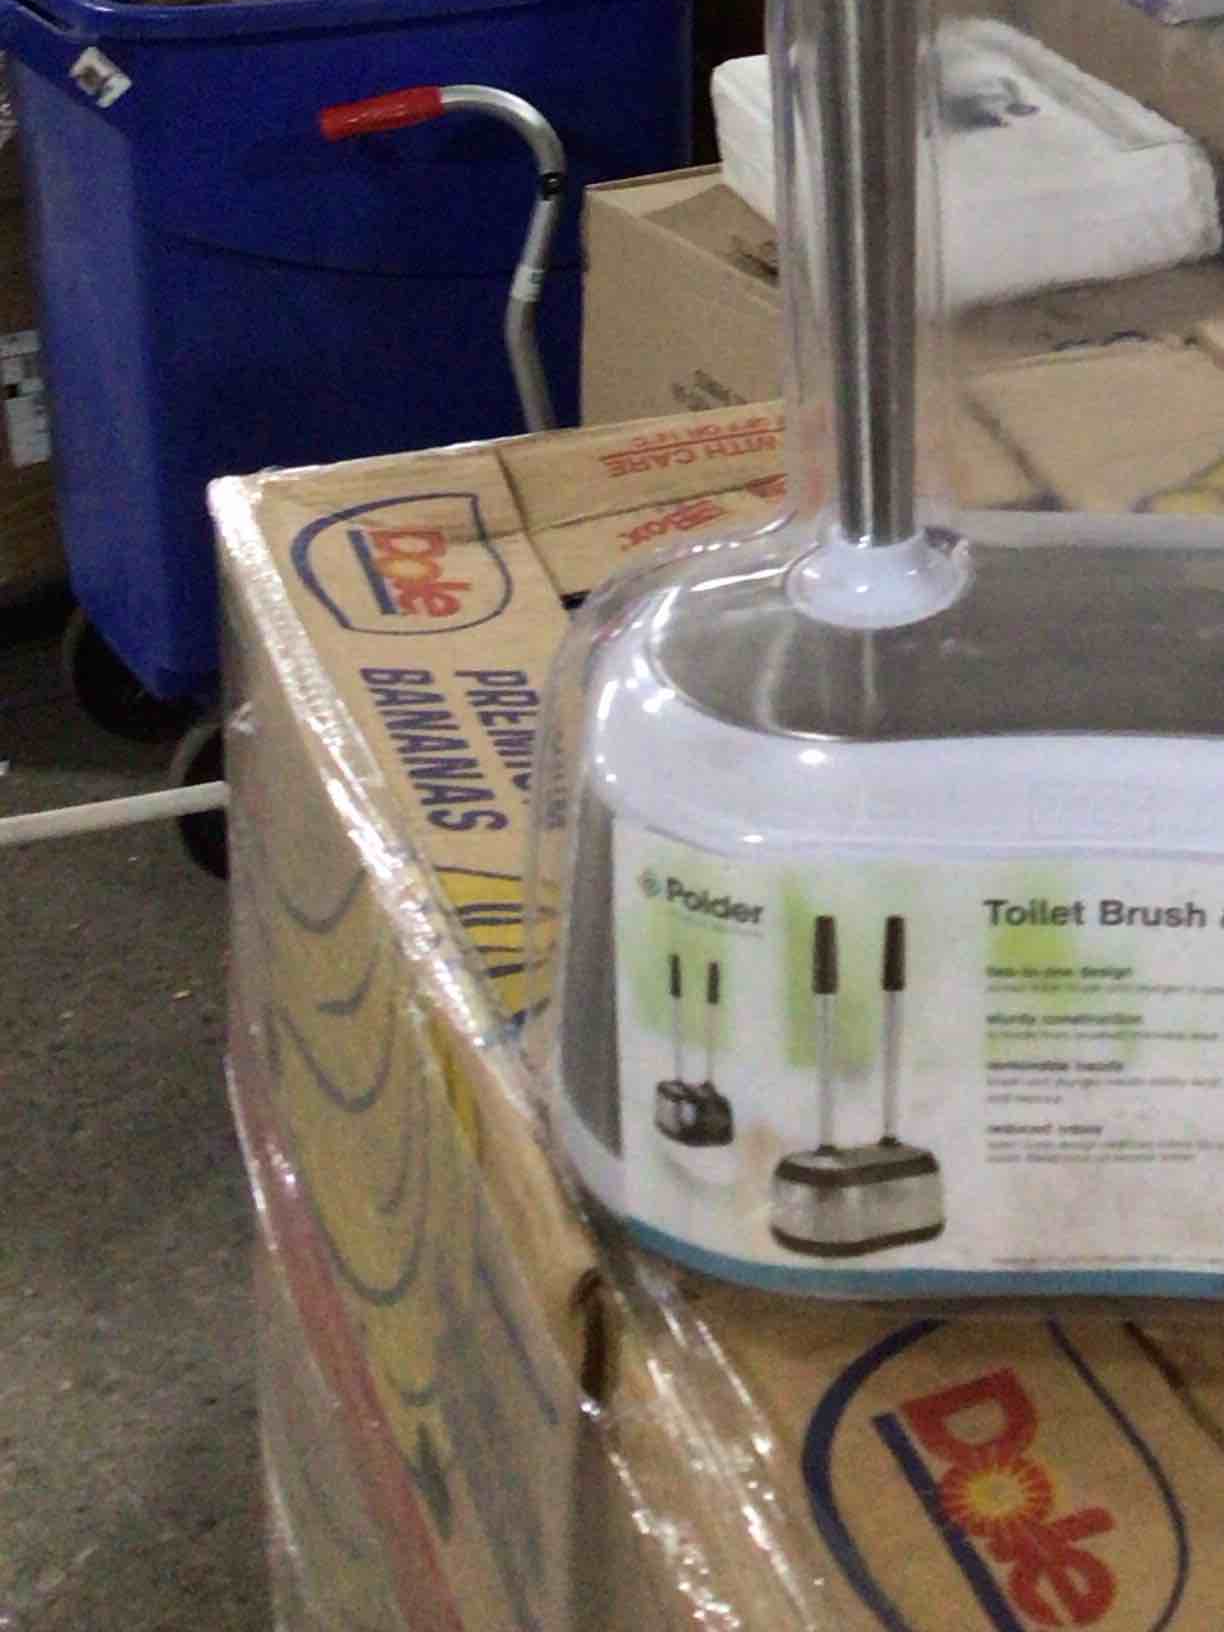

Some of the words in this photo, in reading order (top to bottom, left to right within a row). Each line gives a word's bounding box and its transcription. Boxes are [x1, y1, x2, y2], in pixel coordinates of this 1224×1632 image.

[365, 527, 472, 618] Dole
[359, 667, 509, 831] BANANAS
[982, 898, 1086, 927] Toilet
[1099, 898, 1207, 928] Brush
[900, 1368, 1116, 1631] Dole
